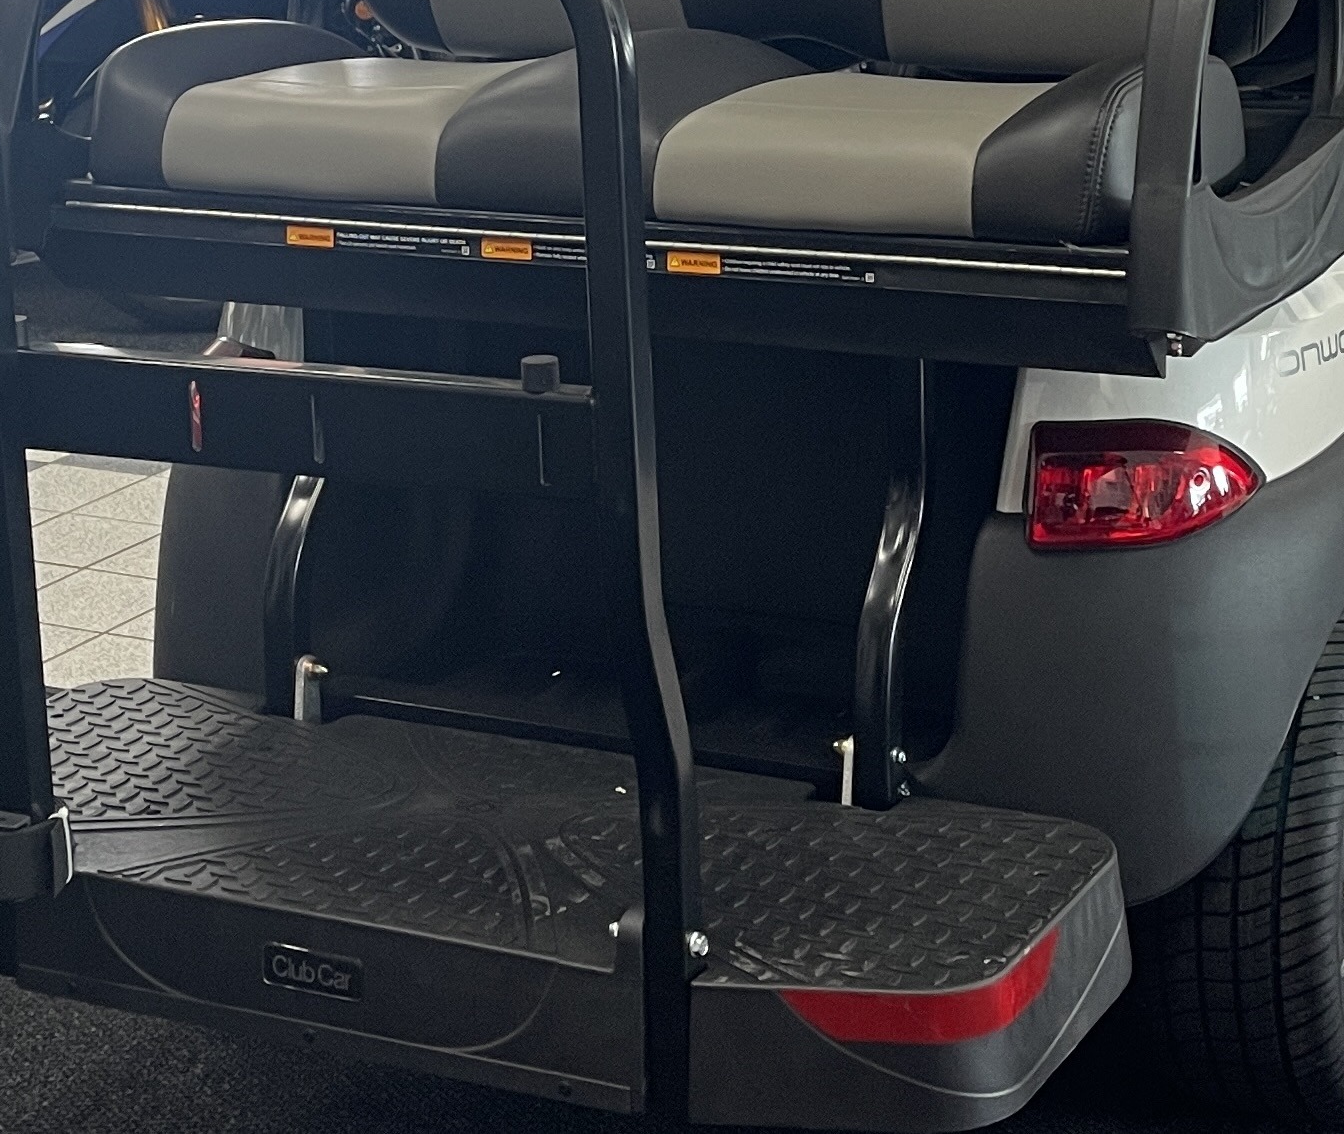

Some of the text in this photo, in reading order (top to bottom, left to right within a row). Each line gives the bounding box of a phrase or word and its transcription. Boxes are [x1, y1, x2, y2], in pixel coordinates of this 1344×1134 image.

[495, 247, 529, 255] WARNING
[681, 258, 718, 268] WARNING
[272, 955, 353, 991] Club Car
